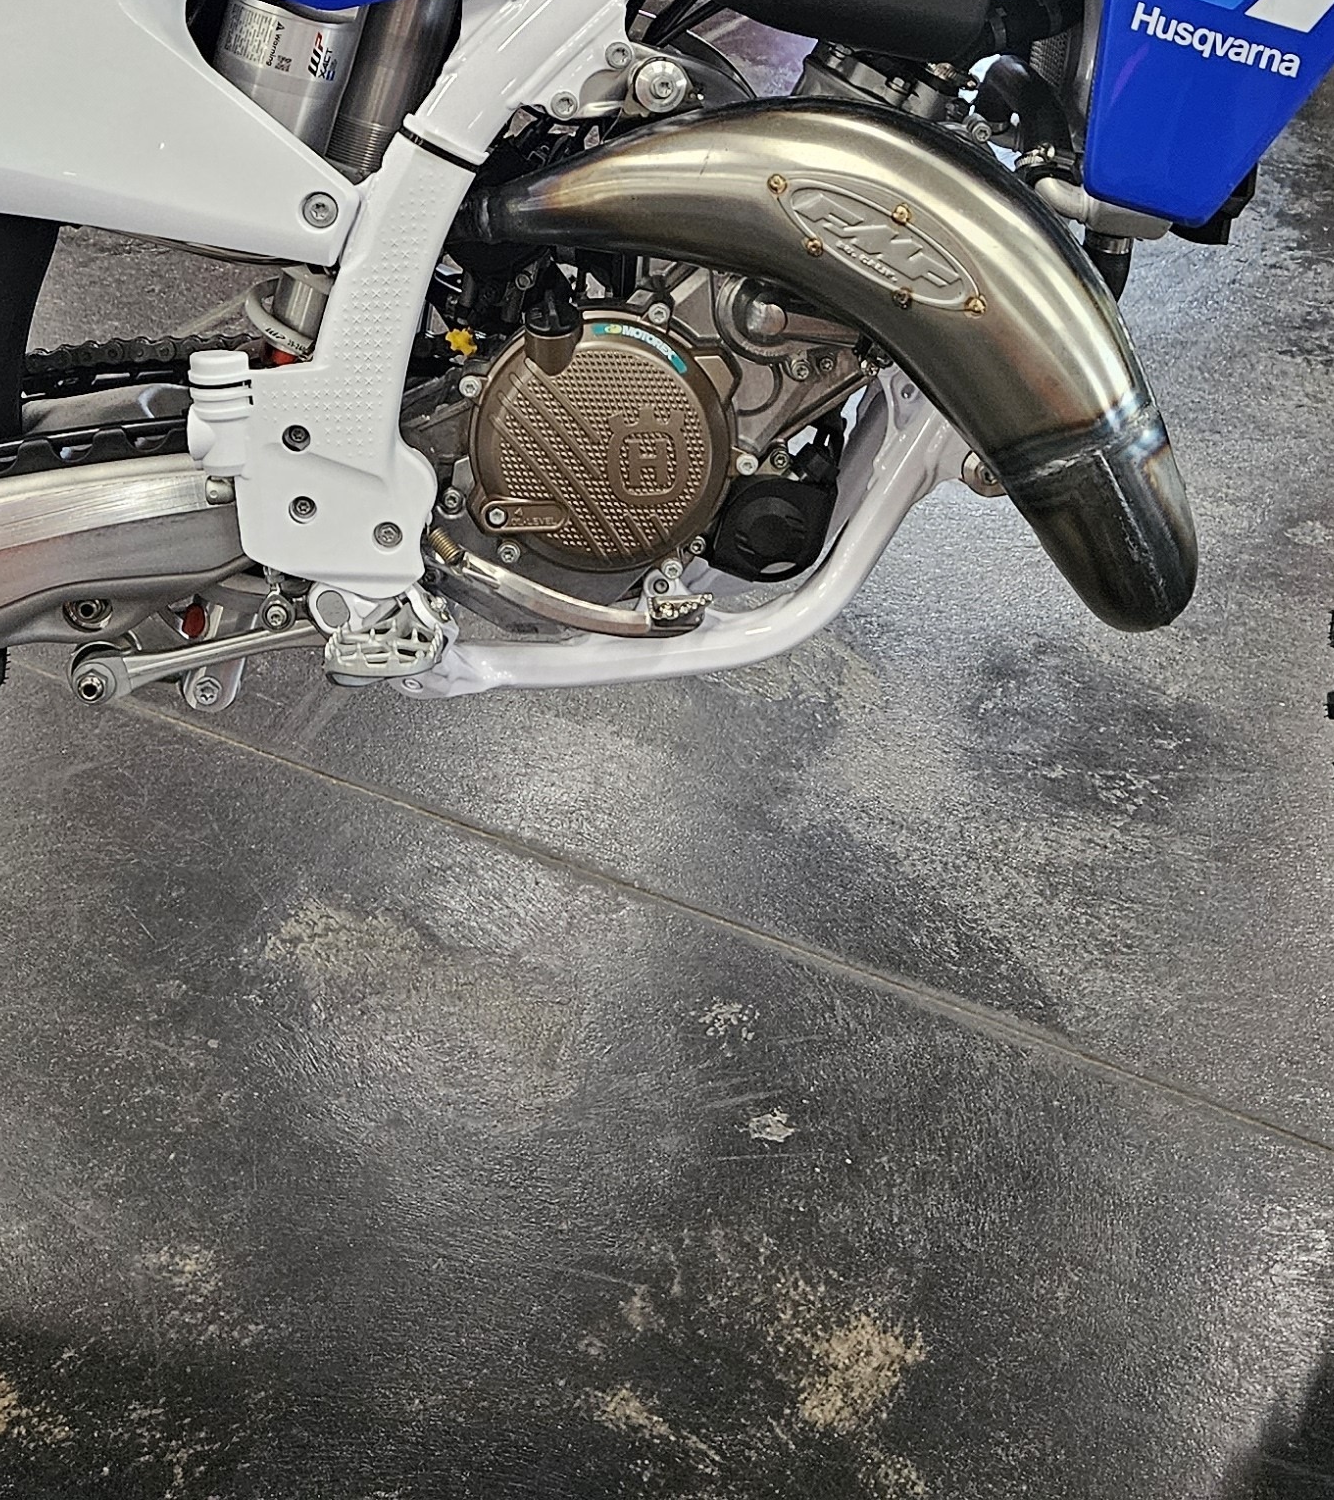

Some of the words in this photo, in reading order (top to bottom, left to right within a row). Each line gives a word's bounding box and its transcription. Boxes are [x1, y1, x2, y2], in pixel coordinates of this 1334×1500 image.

[266, 33, 283, 67] Warning
[1130, 1, 1302, 79] Husqvarna
[318, 47, 333, 79] XACT
[792, 192, 962, 289] FMF
[622, 325, 677, 361] MOTOREX
